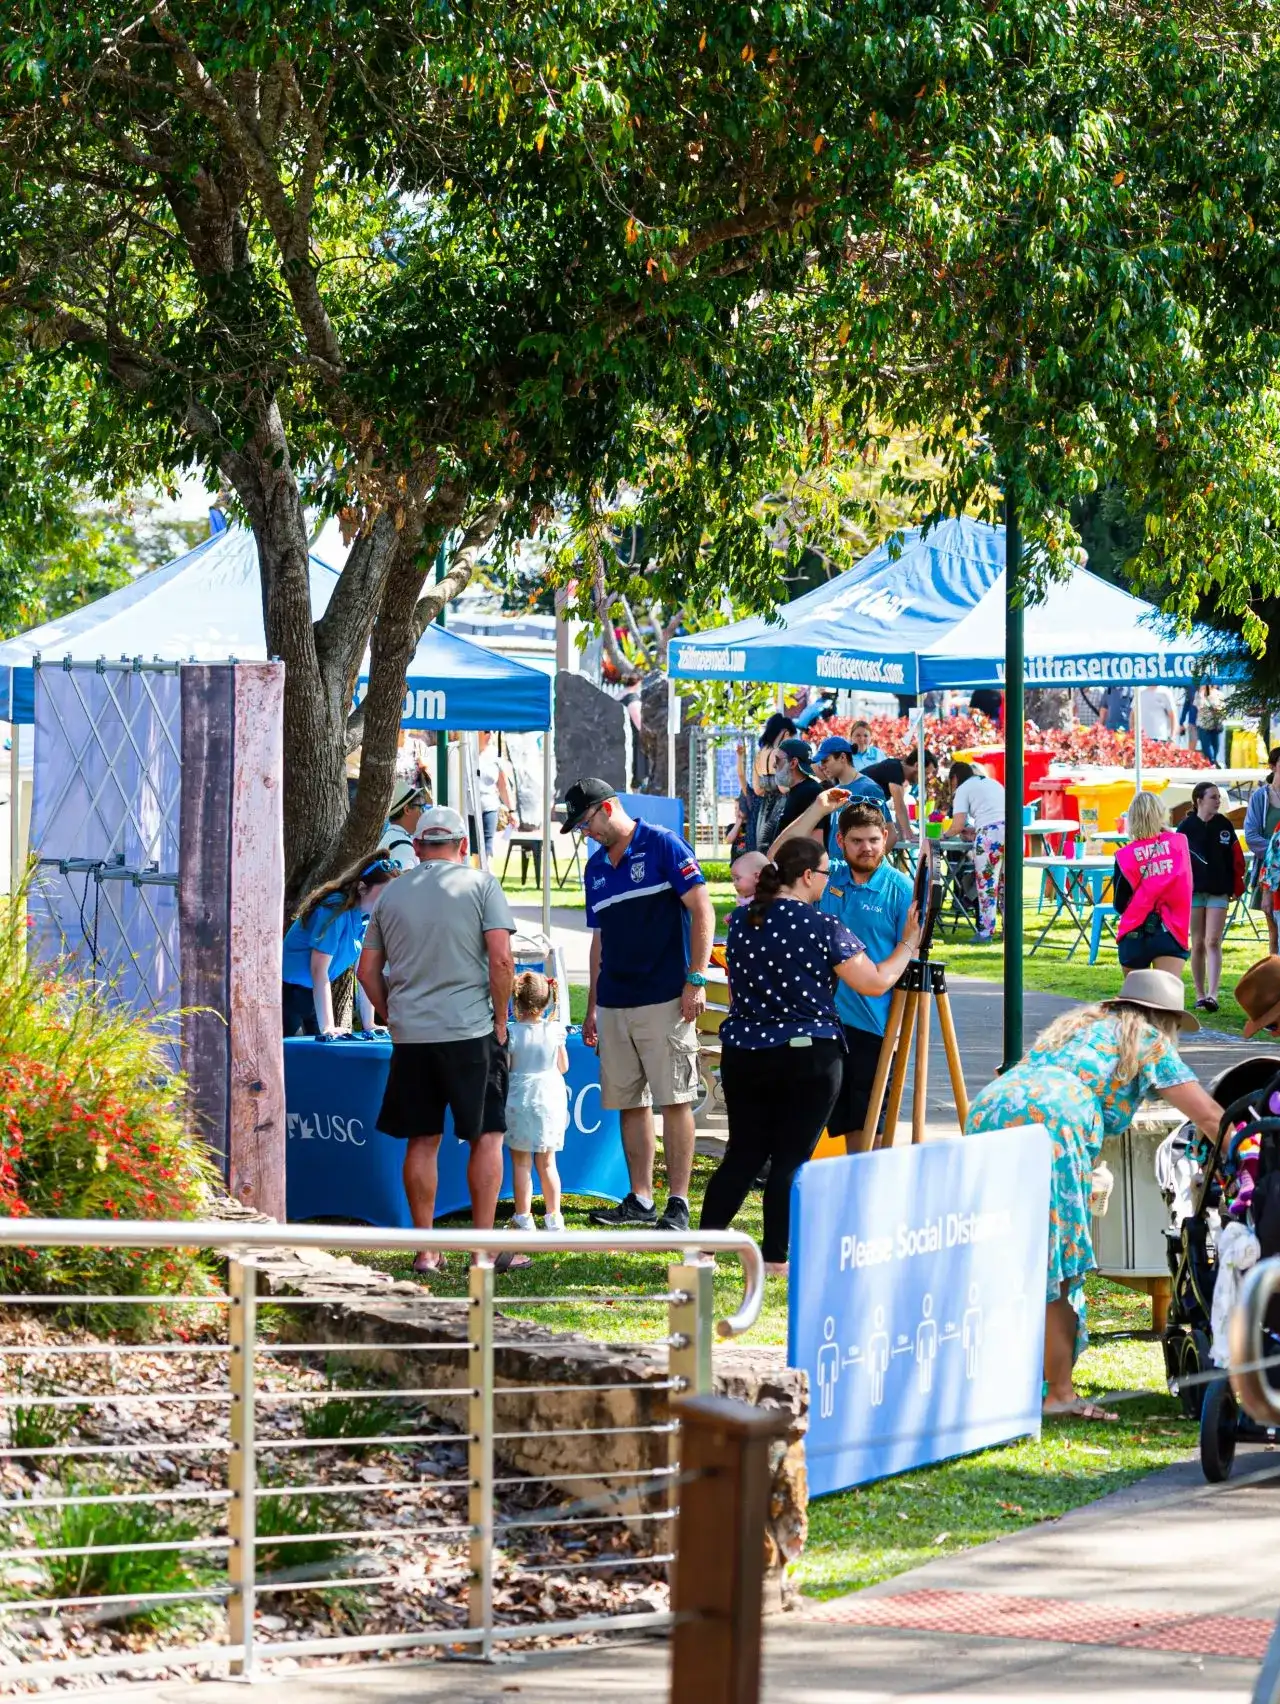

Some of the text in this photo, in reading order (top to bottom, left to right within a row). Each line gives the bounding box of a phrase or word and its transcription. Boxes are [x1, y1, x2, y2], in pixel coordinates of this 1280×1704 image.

[1133, 840, 1170, 861] EVENT
[1140, 859, 1173, 879] STAFF
[313, 1113, 366, 1146] USC
[896, 1217, 942, 1259] Social
